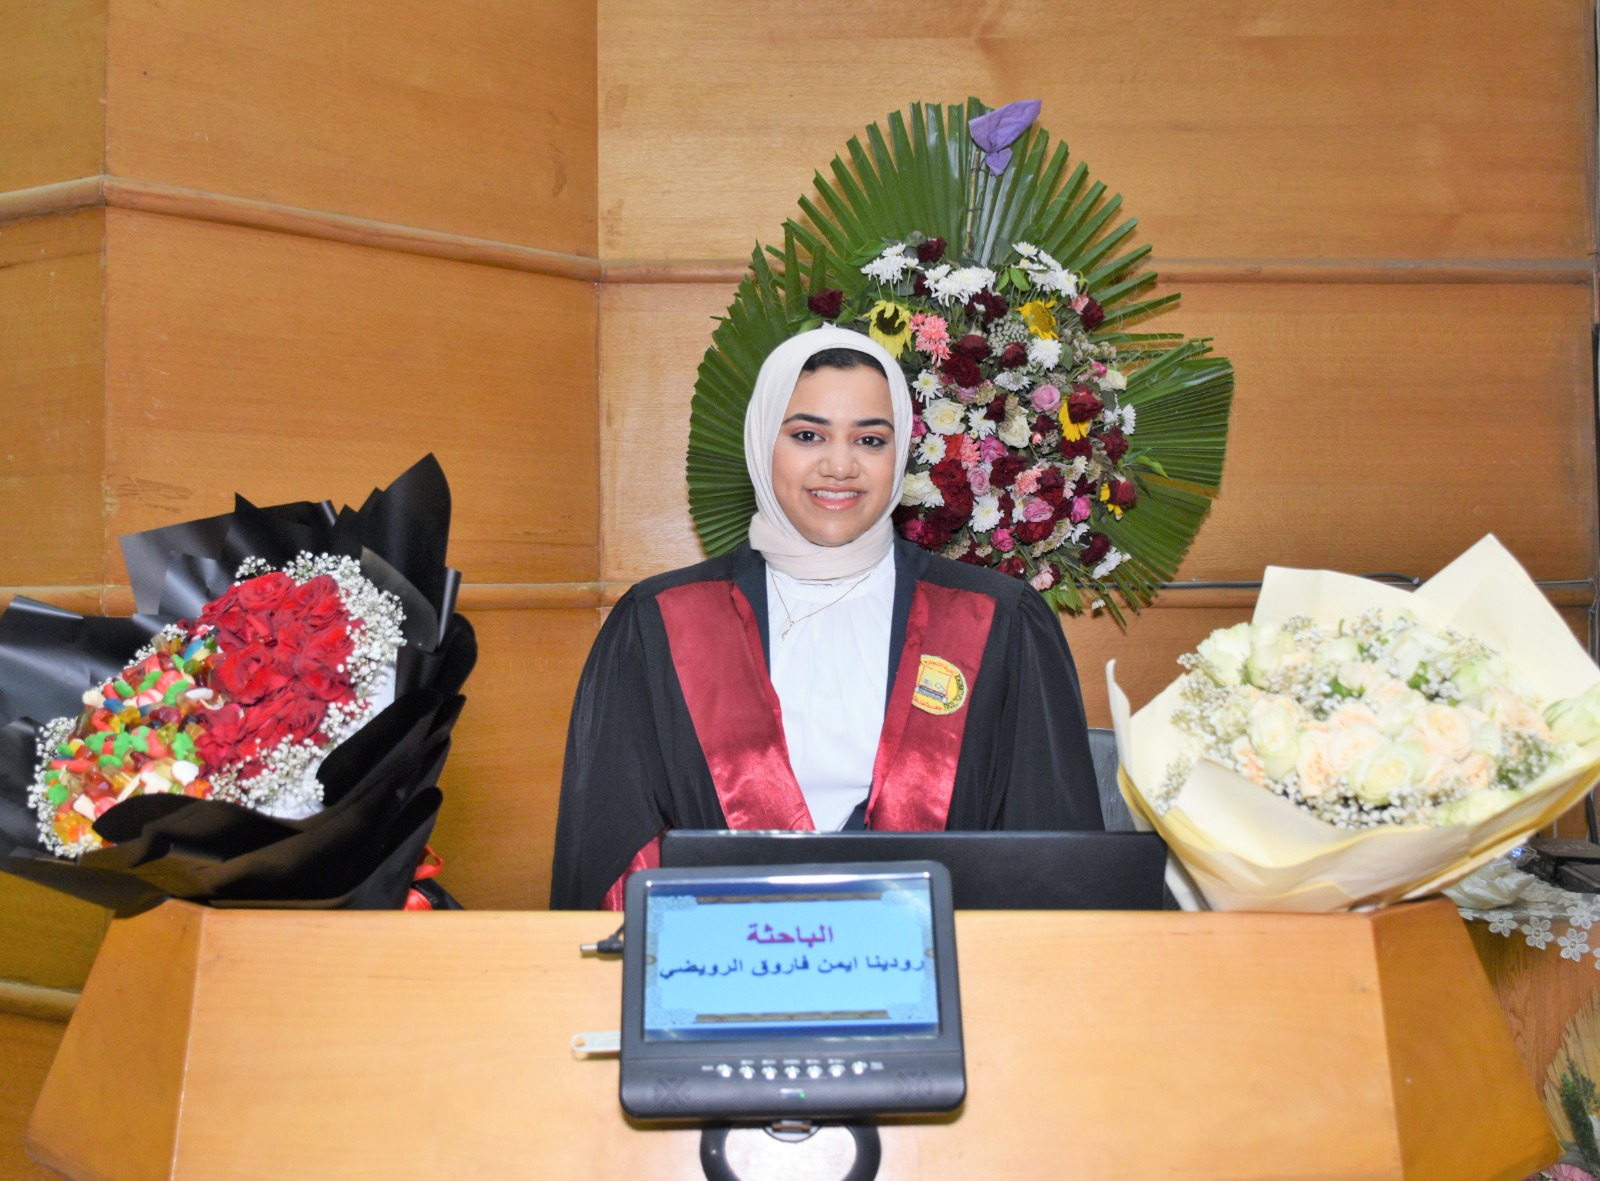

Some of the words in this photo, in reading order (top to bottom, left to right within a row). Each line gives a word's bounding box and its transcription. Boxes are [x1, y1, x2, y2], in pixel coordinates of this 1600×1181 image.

[747, 923, 833, 948] الباحثة
[752, 955, 809, 977] فاروق
[818, 956, 857, 974] ايمن
[865, 955, 925, 972] رودينا
